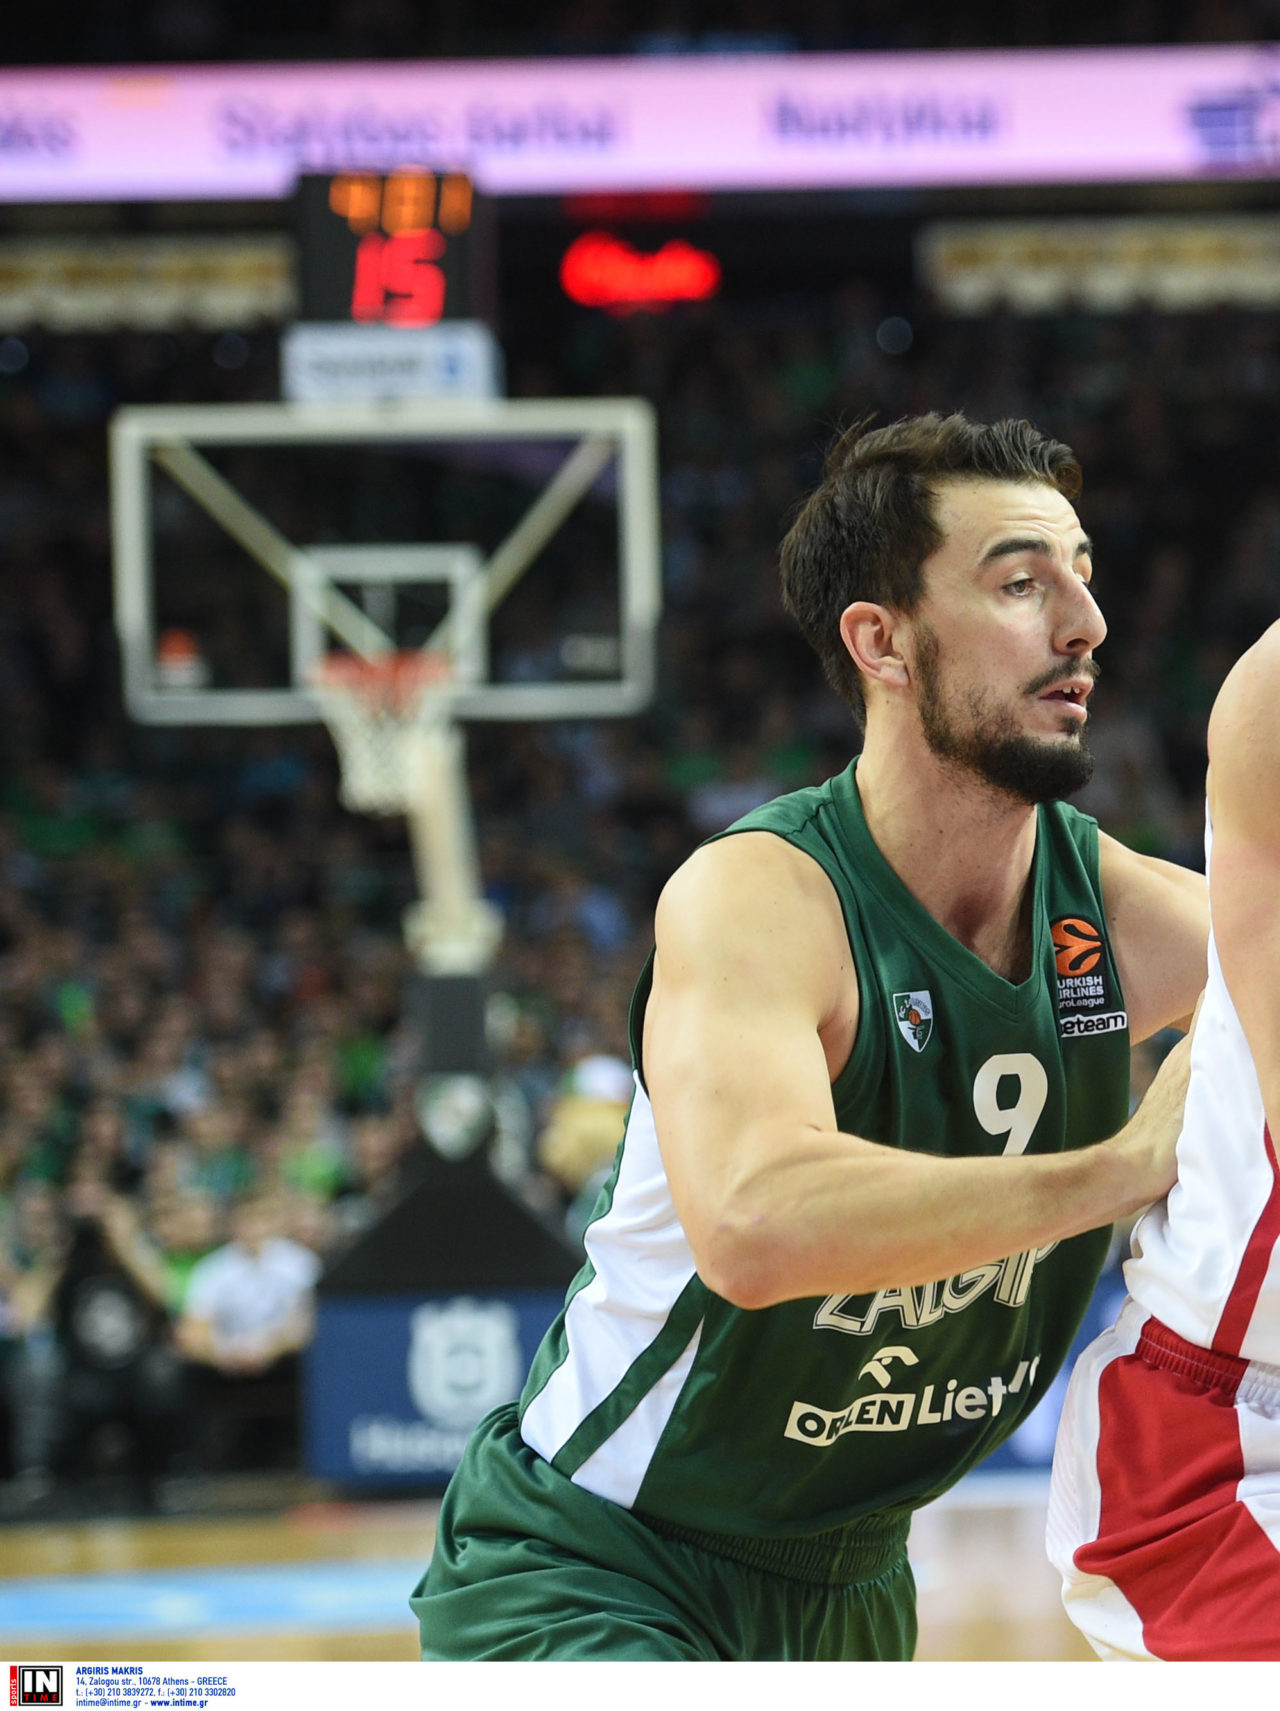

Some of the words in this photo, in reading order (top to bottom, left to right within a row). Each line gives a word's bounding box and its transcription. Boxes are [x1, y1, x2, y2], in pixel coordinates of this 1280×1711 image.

[351, 231, 447, 330] 15
[1057, 975, 1103, 989] URKISH
[1058, 985, 1104, 1000] IRLINES
[1059, 996, 1105, 1010] uroLeague
[1061, 1012, 1125, 1036] eteam
[972, 1052, 1050, 1157] 9
